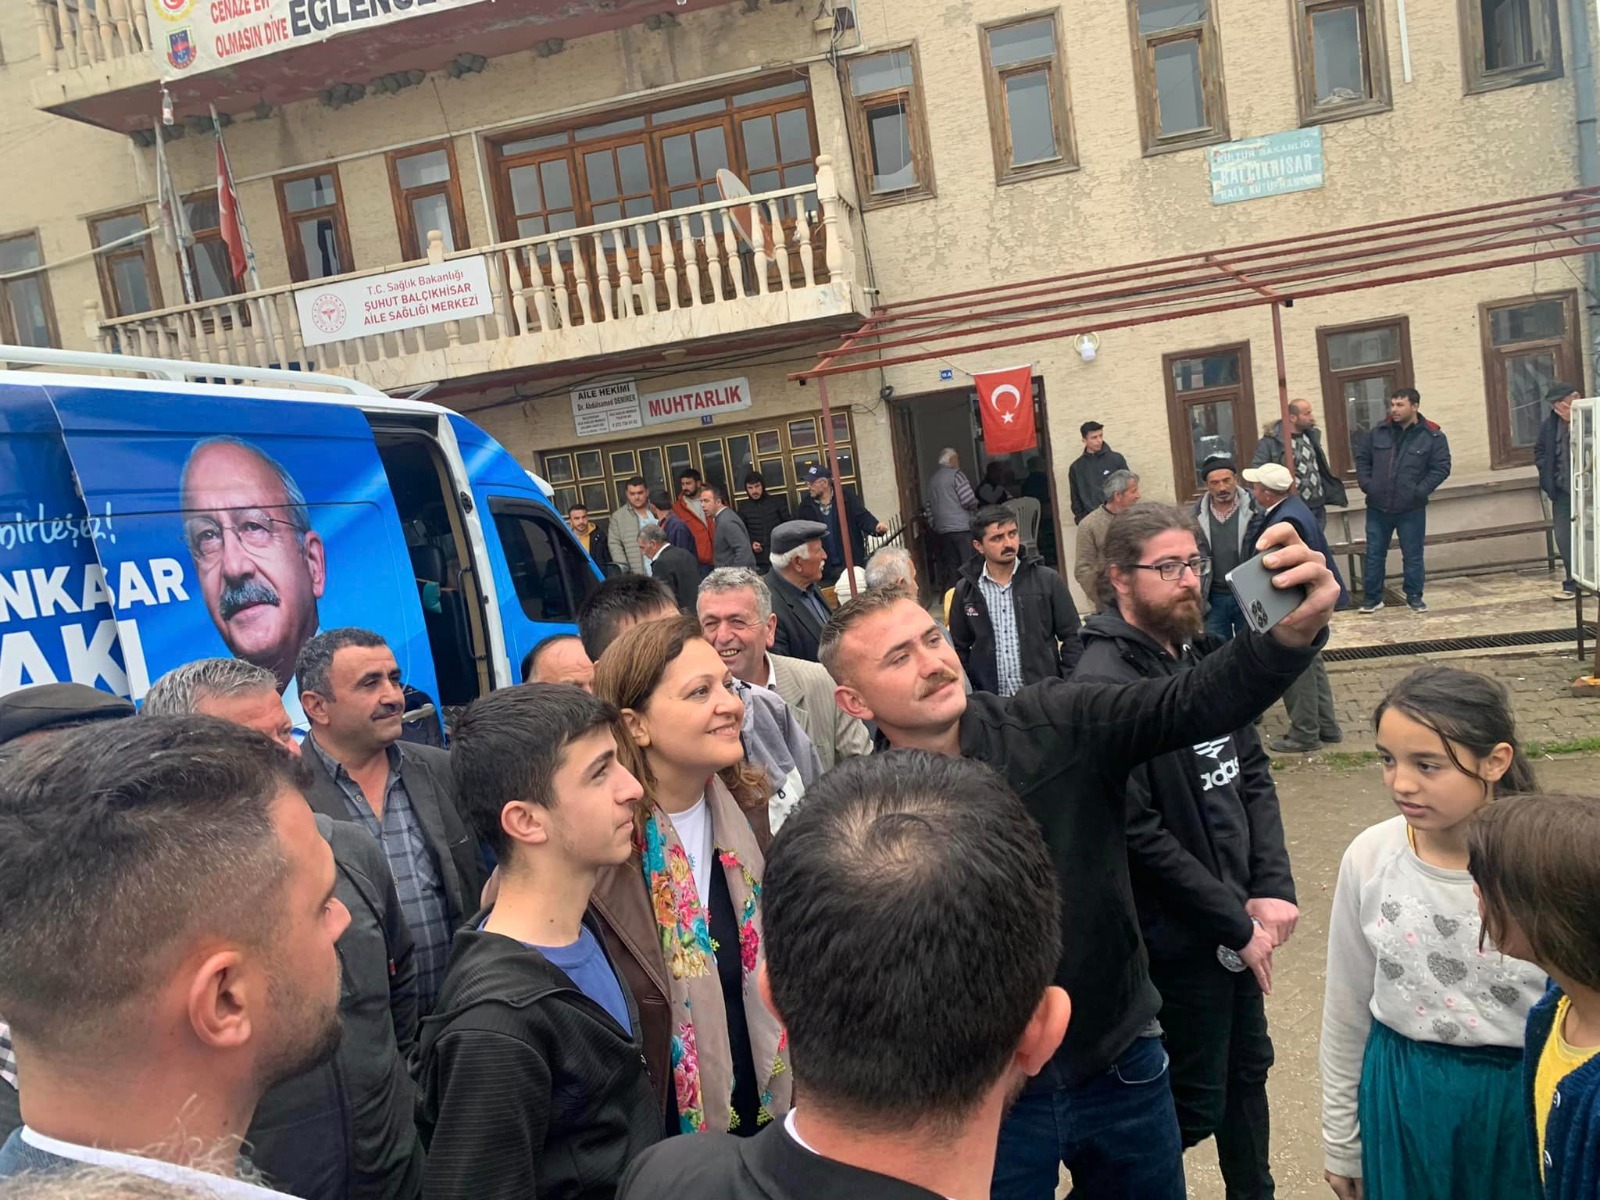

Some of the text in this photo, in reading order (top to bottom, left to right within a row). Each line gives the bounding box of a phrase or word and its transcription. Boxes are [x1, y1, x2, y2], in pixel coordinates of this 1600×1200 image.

[210, 0, 251, 24] CENAZE
[215, 25, 263, 58] OLMASIN
[264, 15, 289, 45] DİYE
[364, 282, 472, 312] ŞUHUT BALÇIKHİSAR
[366, 270, 464, 295] T.C. Sağlık Bakanlığı
[364, 296, 479, 325] AİLE SAĞLIĞI MERKEZİ
[578, 390, 597, 400] AİLE
[648, 385, 742, 417] MUHTARLIK
